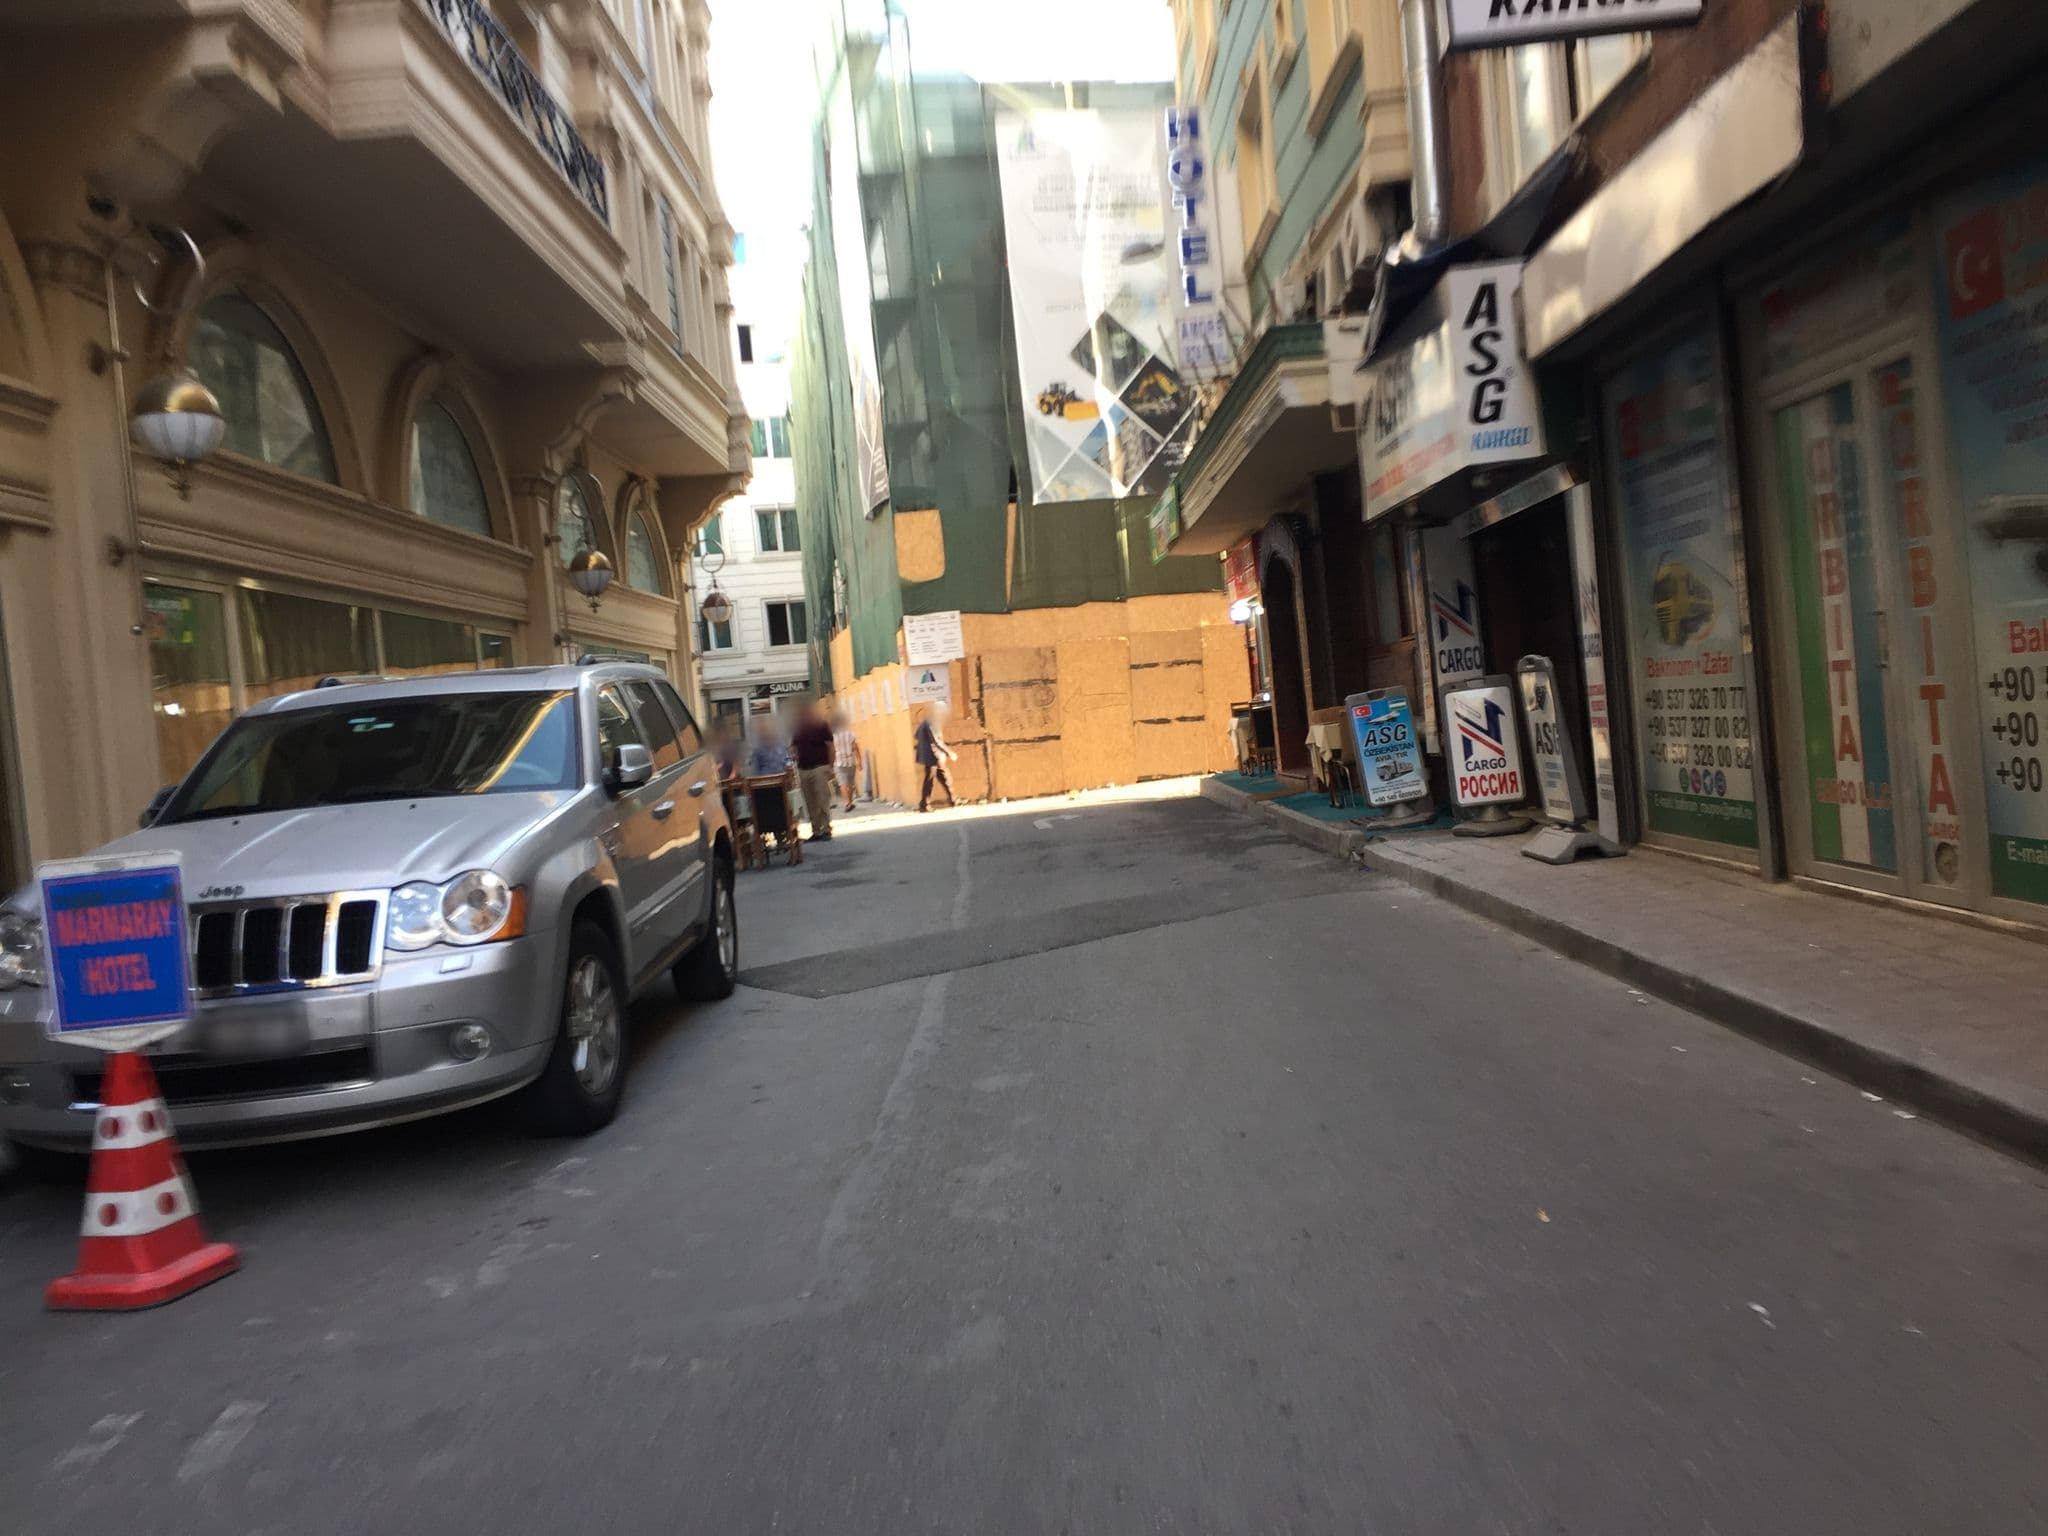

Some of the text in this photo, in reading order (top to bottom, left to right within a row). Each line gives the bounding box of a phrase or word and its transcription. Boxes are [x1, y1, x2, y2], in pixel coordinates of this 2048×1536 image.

[1165, 106, 1212, 307] HOTEL
[1464, 282, 1506, 424] ASG
[1810, 437, 1859, 762] ORBITA
[1889, 409, 1957, 815] ORBITA
[1439, 649, 1483, 673] CARGO
[769, 681, 804, 694] SAUNA
[1689, 687, 1709, 710] 326
[1712, 687, 1727, 709] 70
[1989, 665, 2035, 701] +90
[1364, 723, 1407, 747] ASG
[1715, 717, 1729, 739] 00
[1992, 712, 2039, 747] +90
[1465, 757, 1507, 772] CARGO
[1996, 756, 2042, 792] +90
[1460, 771, 1519, 799] РОССИЯ
[199, 884, 245, 899] Jeep
[82, 952, 156, 995] HOTEL
